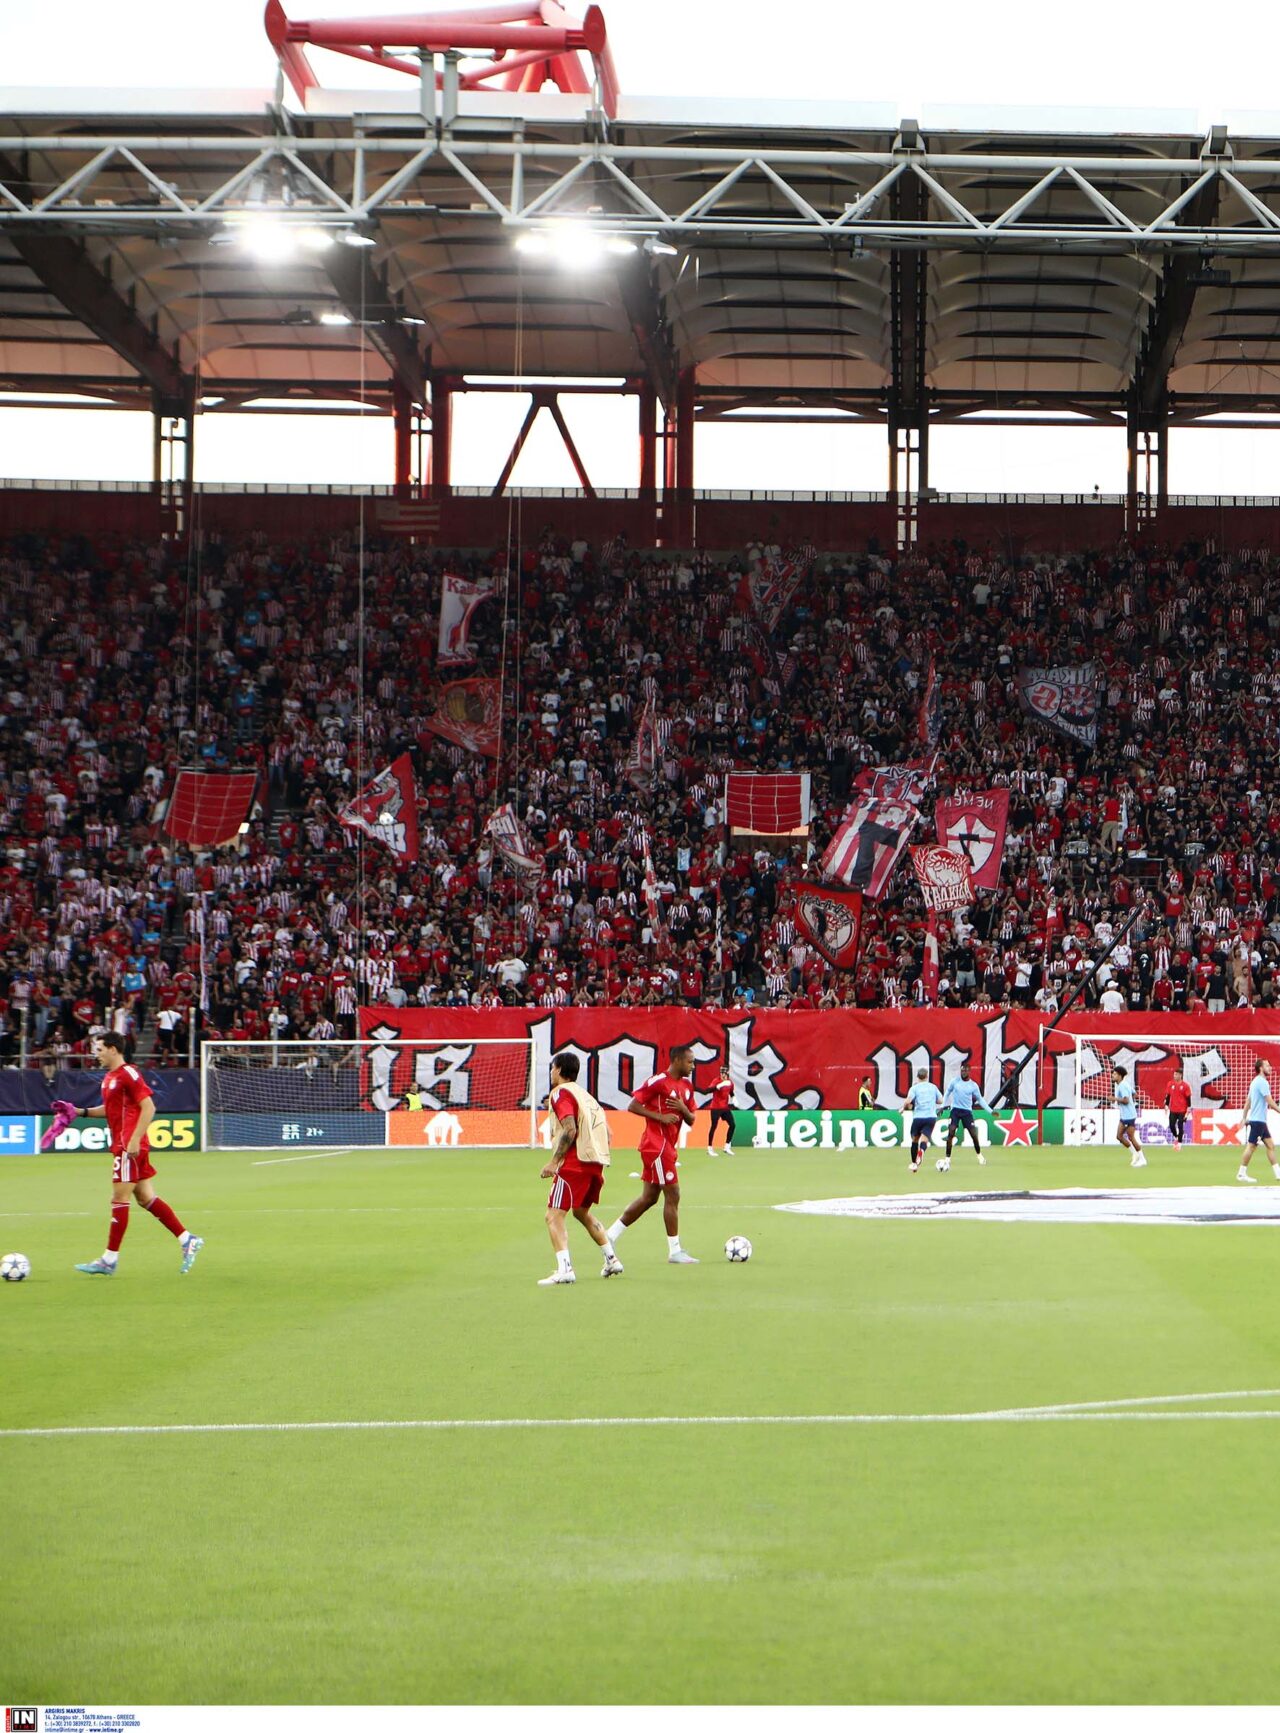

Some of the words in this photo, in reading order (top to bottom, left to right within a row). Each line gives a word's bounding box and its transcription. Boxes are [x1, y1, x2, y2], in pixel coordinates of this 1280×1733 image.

[361, 1020, 477, 1111] is
[866, 1013, 1231, 1110] where
[54, 1119, 196, 1150] bet65
